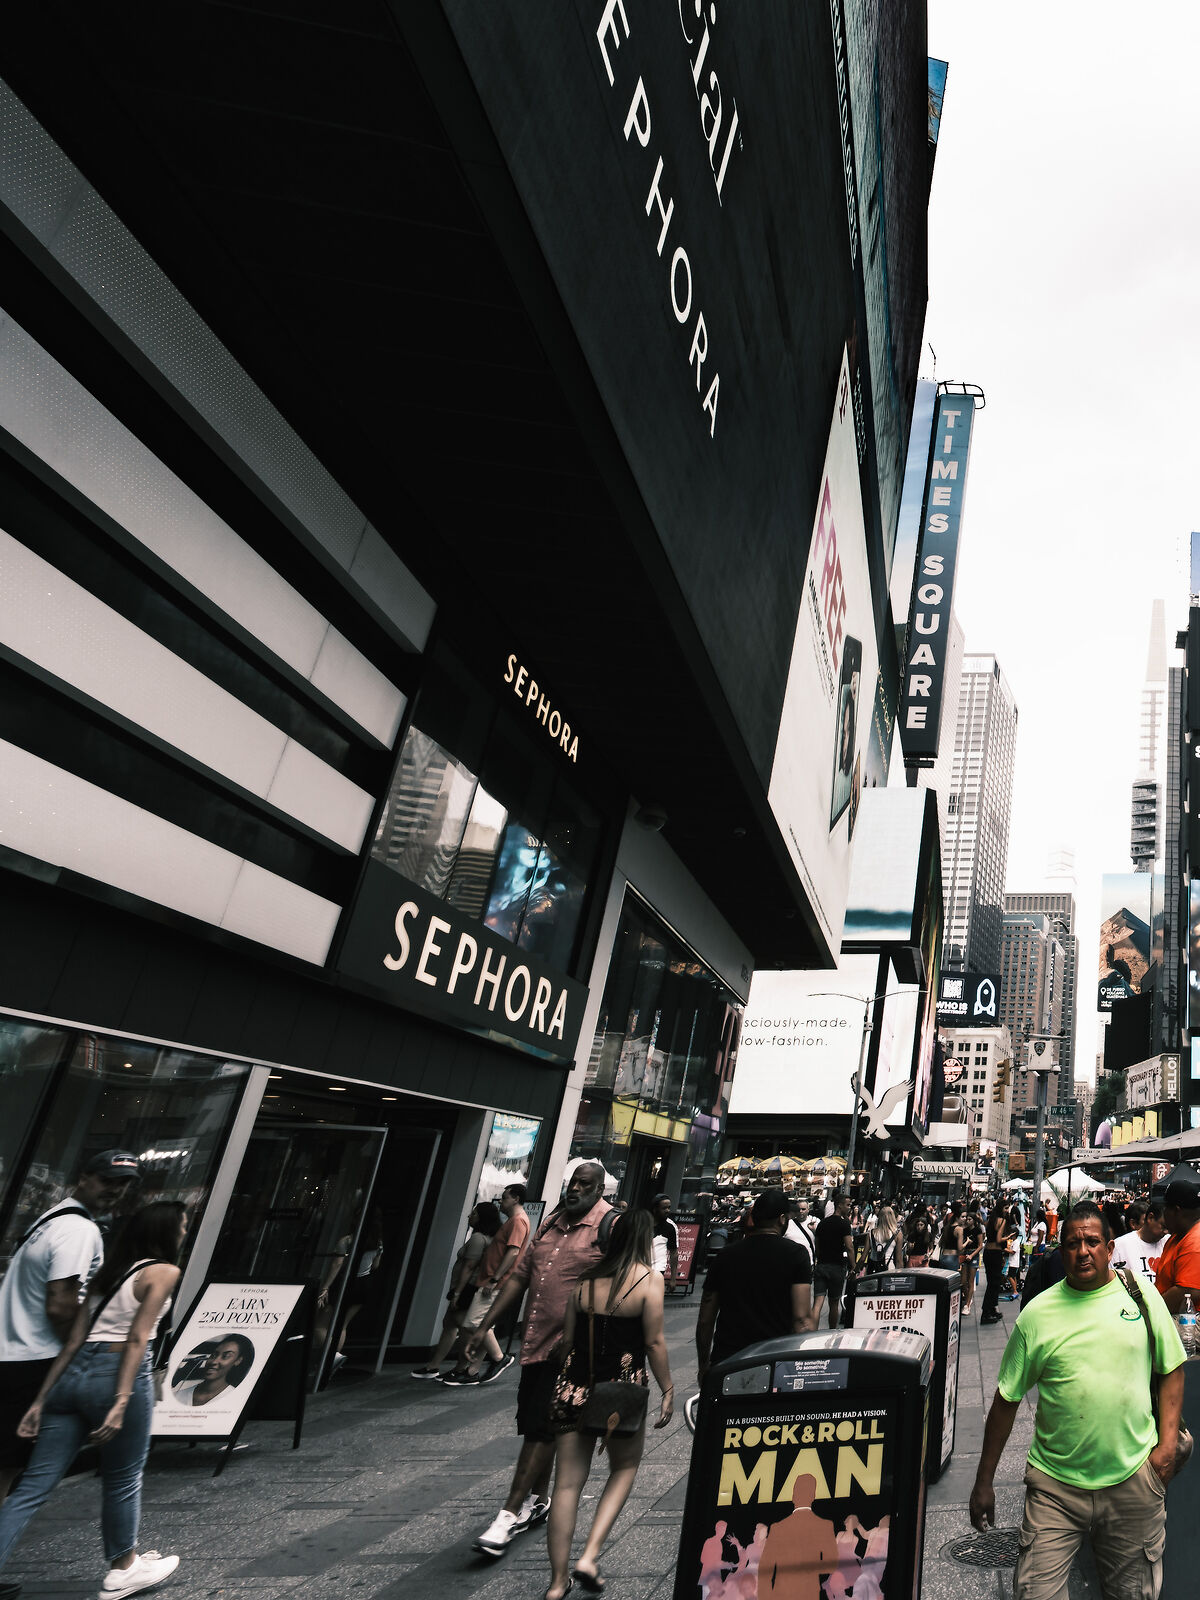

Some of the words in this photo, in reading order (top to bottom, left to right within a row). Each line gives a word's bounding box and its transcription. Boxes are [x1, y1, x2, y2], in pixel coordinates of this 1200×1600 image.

[927, 410, 961, 534] TIMES
[906, 555, 945, 729] SQUARE
[503, 654, 579, 763] SEPHORA
[383, 901, 569, 1041] SEPHORA
[913, 1164, 974, 1176] SWAROVSKI
[198, 1311, 225, 1324] 250
[226, 1297, 270, 1310] EARN
[876, 1299, 902, 1310] VERY
[904, 1298, 925, 1309] HOT
[741, 1416, 775, 1424] BUSINESS
[775, 1415, 795, 1423] BUILT
[795, 1414, 805, 1422] ON
[863, 1409, 888, 1417] VISION.
[717, 1443, 884, 1507] MAN
